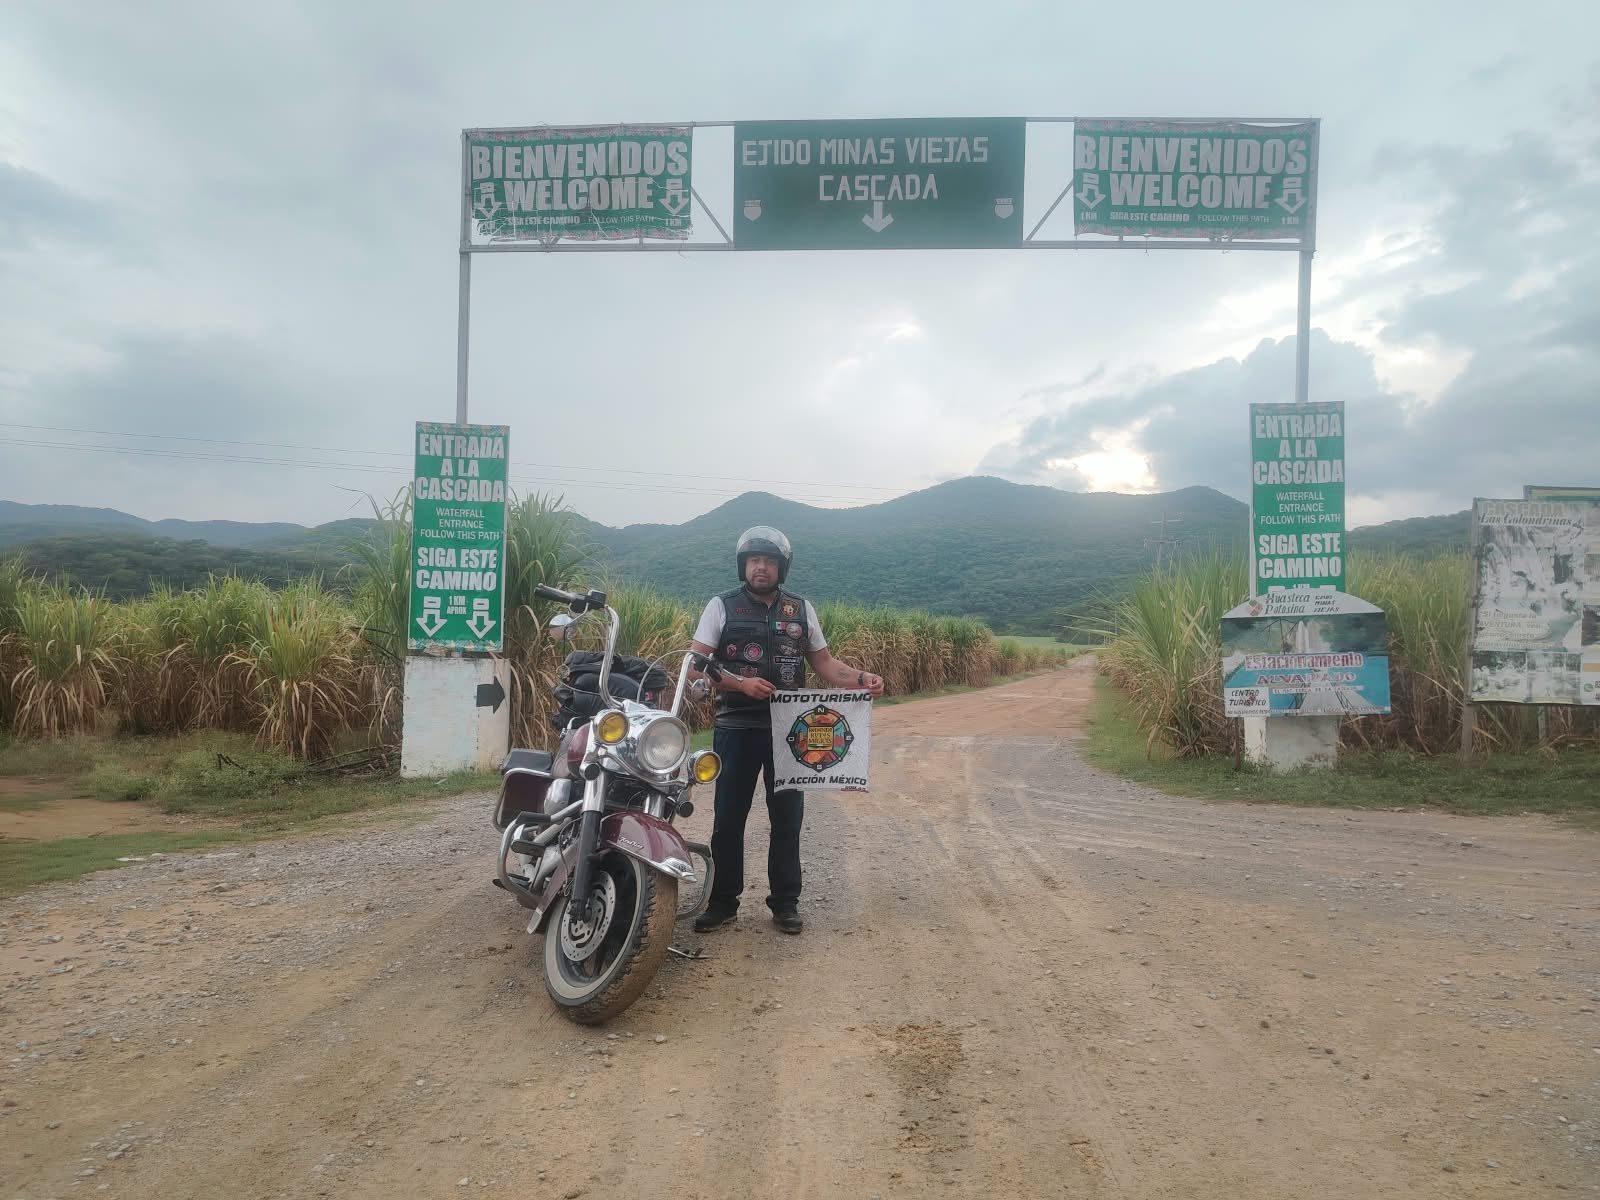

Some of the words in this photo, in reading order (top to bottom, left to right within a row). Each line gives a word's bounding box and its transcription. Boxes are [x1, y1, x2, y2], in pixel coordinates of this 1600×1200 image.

[742, 139, 811, 166] EJIDO
[820, 137, 896, 165] MINAS
[904, 136, 989, 164] VIEJAS
[1075, 134, 1306, 175] BIENVENIDOS
[472, 141, 688, 180] BIENVENIDOS
[819, 174, 939, 201] CASCADA
[1109, 173, 1272, 210] WELCOME
[504, 177, 654, 211] WELCOME
[543, 216, 580, 225] CAMINO
[588, 216, 620, 225] FOLLOW
[1085, 212, 1098, 221] KM
[1110, 212, 1129, 220] SIGA
[1130, 213, 1149, 221] ESTE
[1150, 213, 1190, 222] CAMINO
[1197, 214, 1230, 222] FOLLOW
[1231, 214, 1248, 223] THIS
[1250, 215, 1270, 224] PATH
[1255, 414, 1342, 438] ENTRADA
[420, 434, 504, 459] ENTRADA
[1279, 440, 1291, 458] A
[1296, 439, 1317, 458] LA
[440, 458, 453, 476] A
[458, 460, 479, 477] LA
[1254, 459, 1344, 485] CASCADA
[416, 477, 504, 503] CASCADA
[1276, 491, 1324, 501] WATERFALL
[436, 508, 485, 518] WATERFALL
[1279, 503, 1324, 512] ENTRANCE
[439, 518, 484, 529] ENTRANCE
[1260, 515, 1294, 525] FOLLOW
[1297, 514, 1316, 524] THIS
[1318, 514, 1341, 523] PATH
[1504, 513, 1573, 526] Golondrinas
[420, 529, 455, 539] FOLLOW
[457, 530, 476, 540] THIS
[478, 531, 500, 540] PATH
[1259, 534, 1298, 556] SIGA
[1302, 533, 1341, 554] ESTE
[418, 547, 457, 568] SIGA
[460, 549, 497, 569] ESTE
[1258, 557, 1342, 578] CAMINO
[416, 570, 497, 592] CAMINO
[449, 596, 452, 605] 1
[454, 596, 466, 605] KM
[1265, 593, 1310, 604] Huasteca
[446, 606, 467, 614] APROX
[1264, 604, 1305, 614] Potosina
[1257, 673, 1356, 684] ALVARADO
[770, 692, 872, 703] MOTOTURISMO
[788, 774, 825, 784] ACCIÓN
[829, 775, 866, 785] MÉXICO
